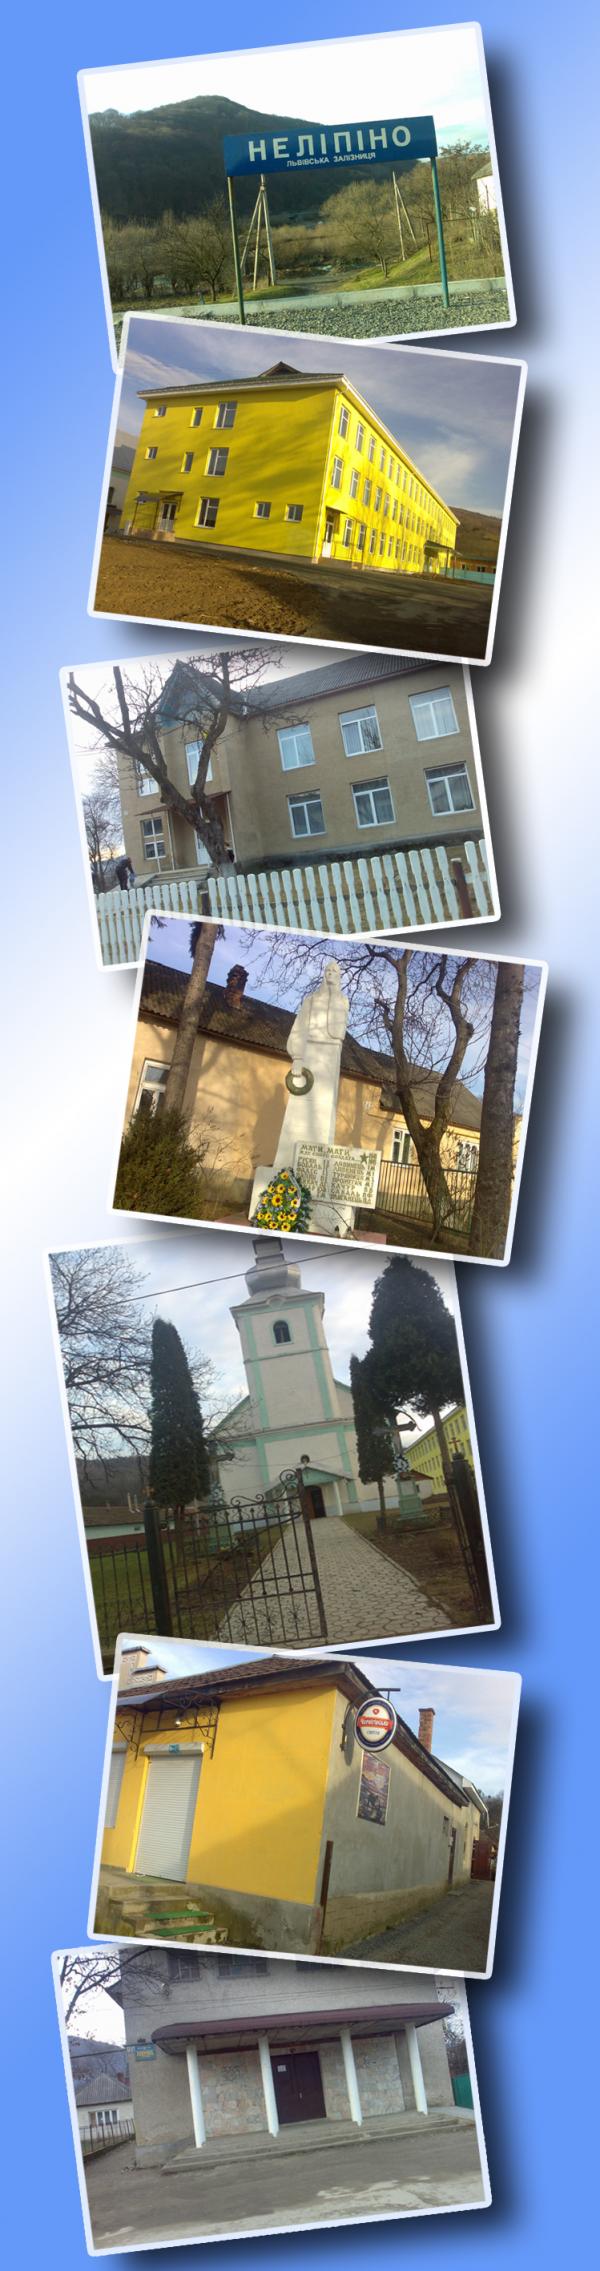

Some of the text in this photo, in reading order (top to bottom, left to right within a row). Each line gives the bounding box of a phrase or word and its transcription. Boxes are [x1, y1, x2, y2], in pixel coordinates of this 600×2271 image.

[248, 125, 411, 162] НЕЛІПІНО
[286, 152, 376, 168] ЛЬВІВСЬКА ЗАЛІЗНИЦЯ
